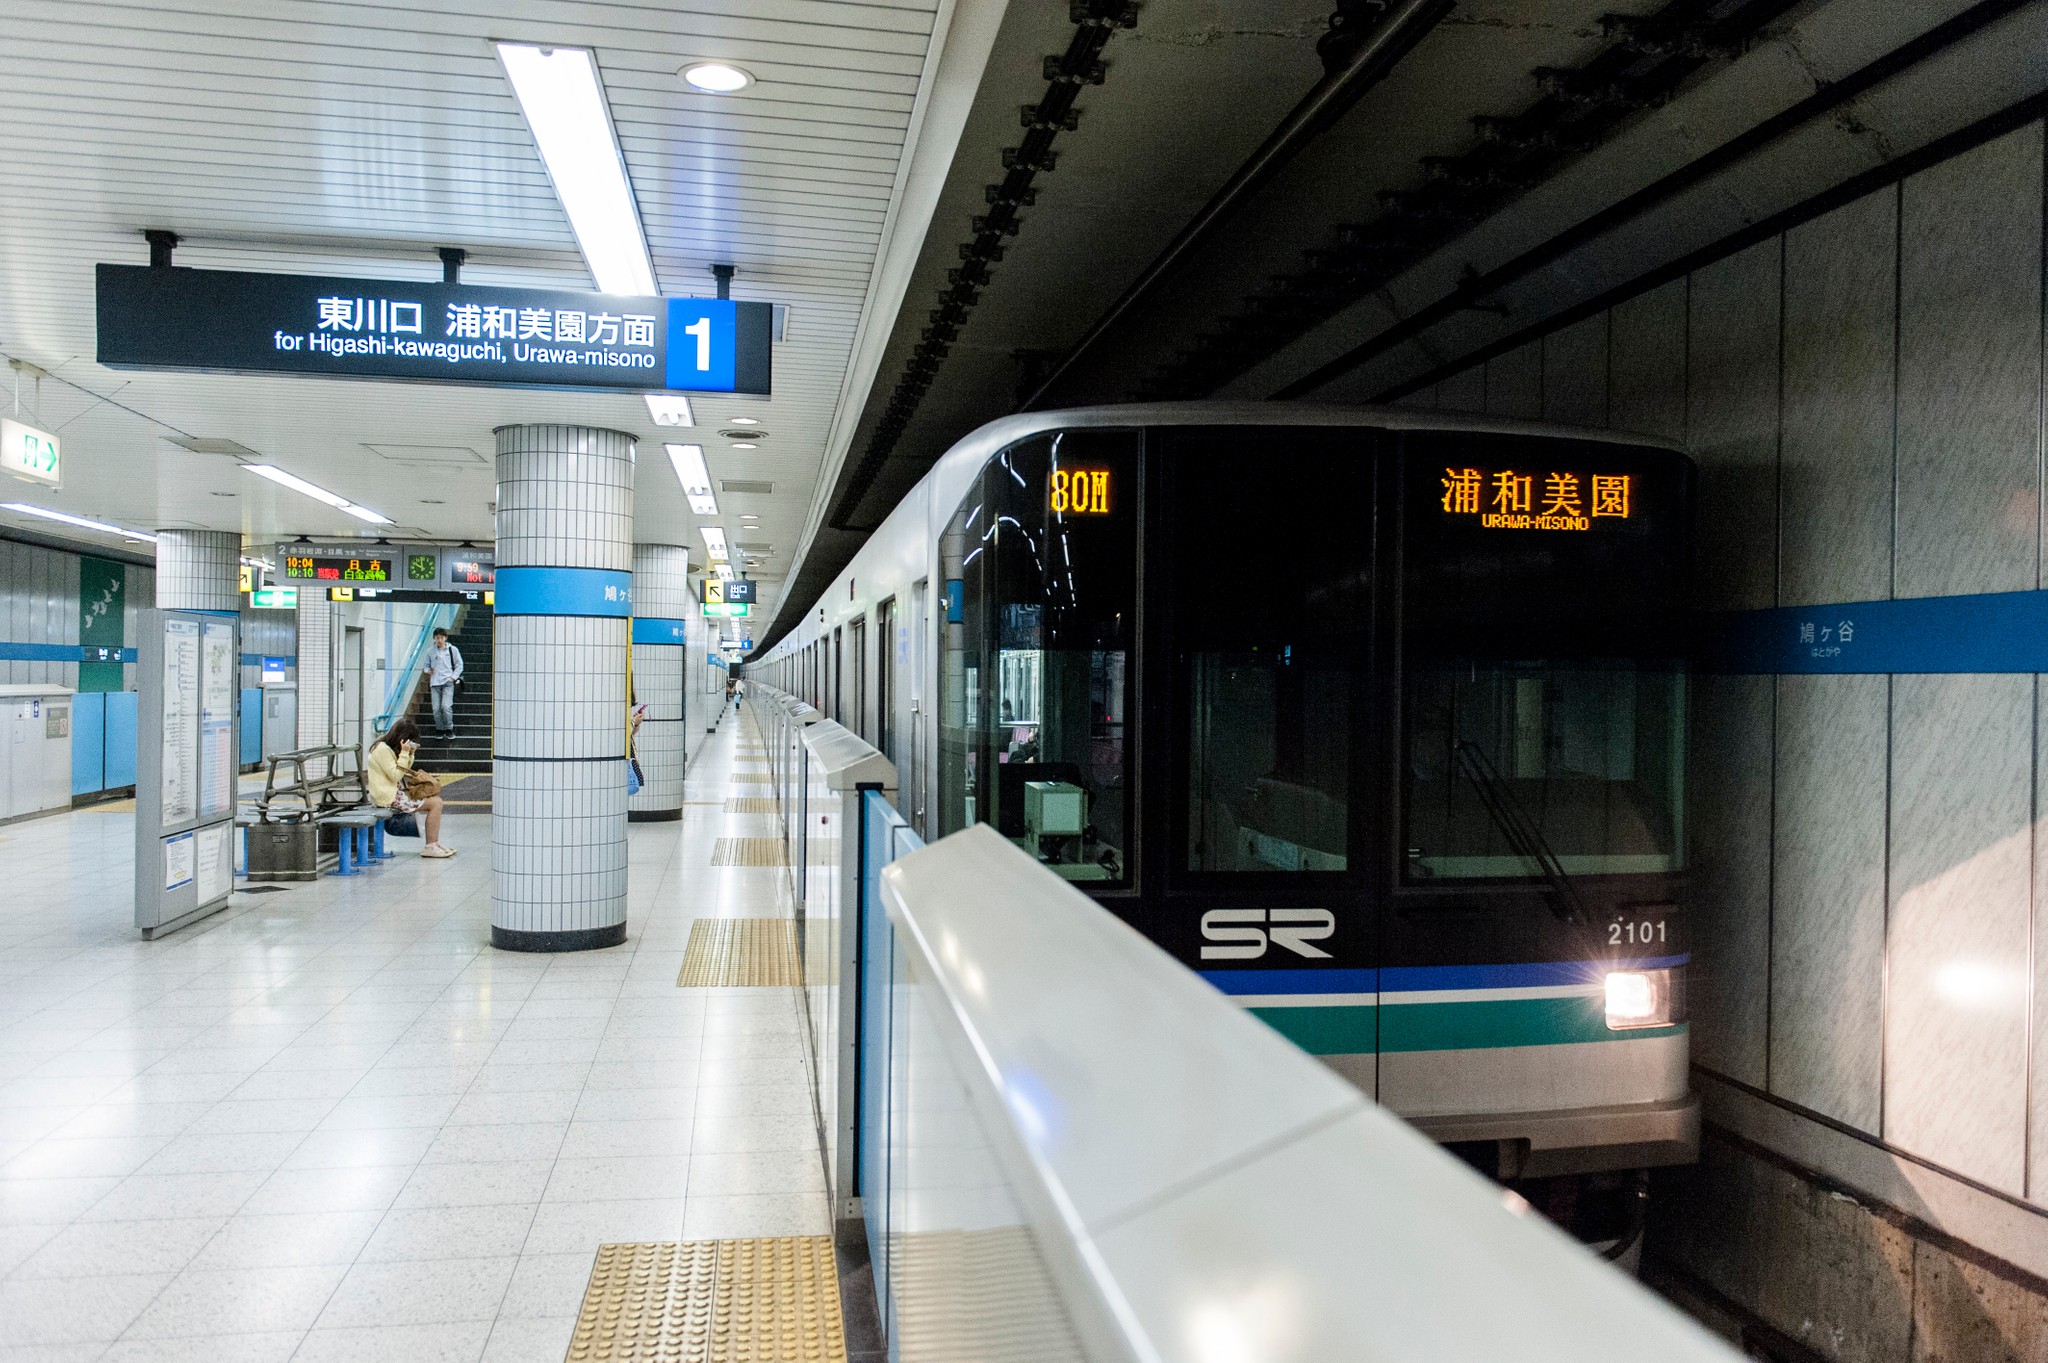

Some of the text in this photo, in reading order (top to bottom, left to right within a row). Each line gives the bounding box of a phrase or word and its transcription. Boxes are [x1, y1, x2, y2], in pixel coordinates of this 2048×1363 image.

[317, 296, 656, 347] 東川口 浦和美園方面
[275, 331, 656, 368] for Higashi-kawaguchi, Urawa-misono
[685, 317, 711, 371] 1
[1051, 470, 1109, 512] 80M
[1441, 468, 1630, 518] 浦和美園
[1482, 513, 1590, 530] URAWA-MISONO
[286, 557, 313, 568] 10:04
[287, 568, 313, 578] 10:10
[457, 562, 479, 573] 9:59
[466, 572, 482, 583] Not
[1811, 647, 1841, 658] はとがや
[1200, 908, 1336, 960] SR
[1608, 921, 1666, 945] 2101
